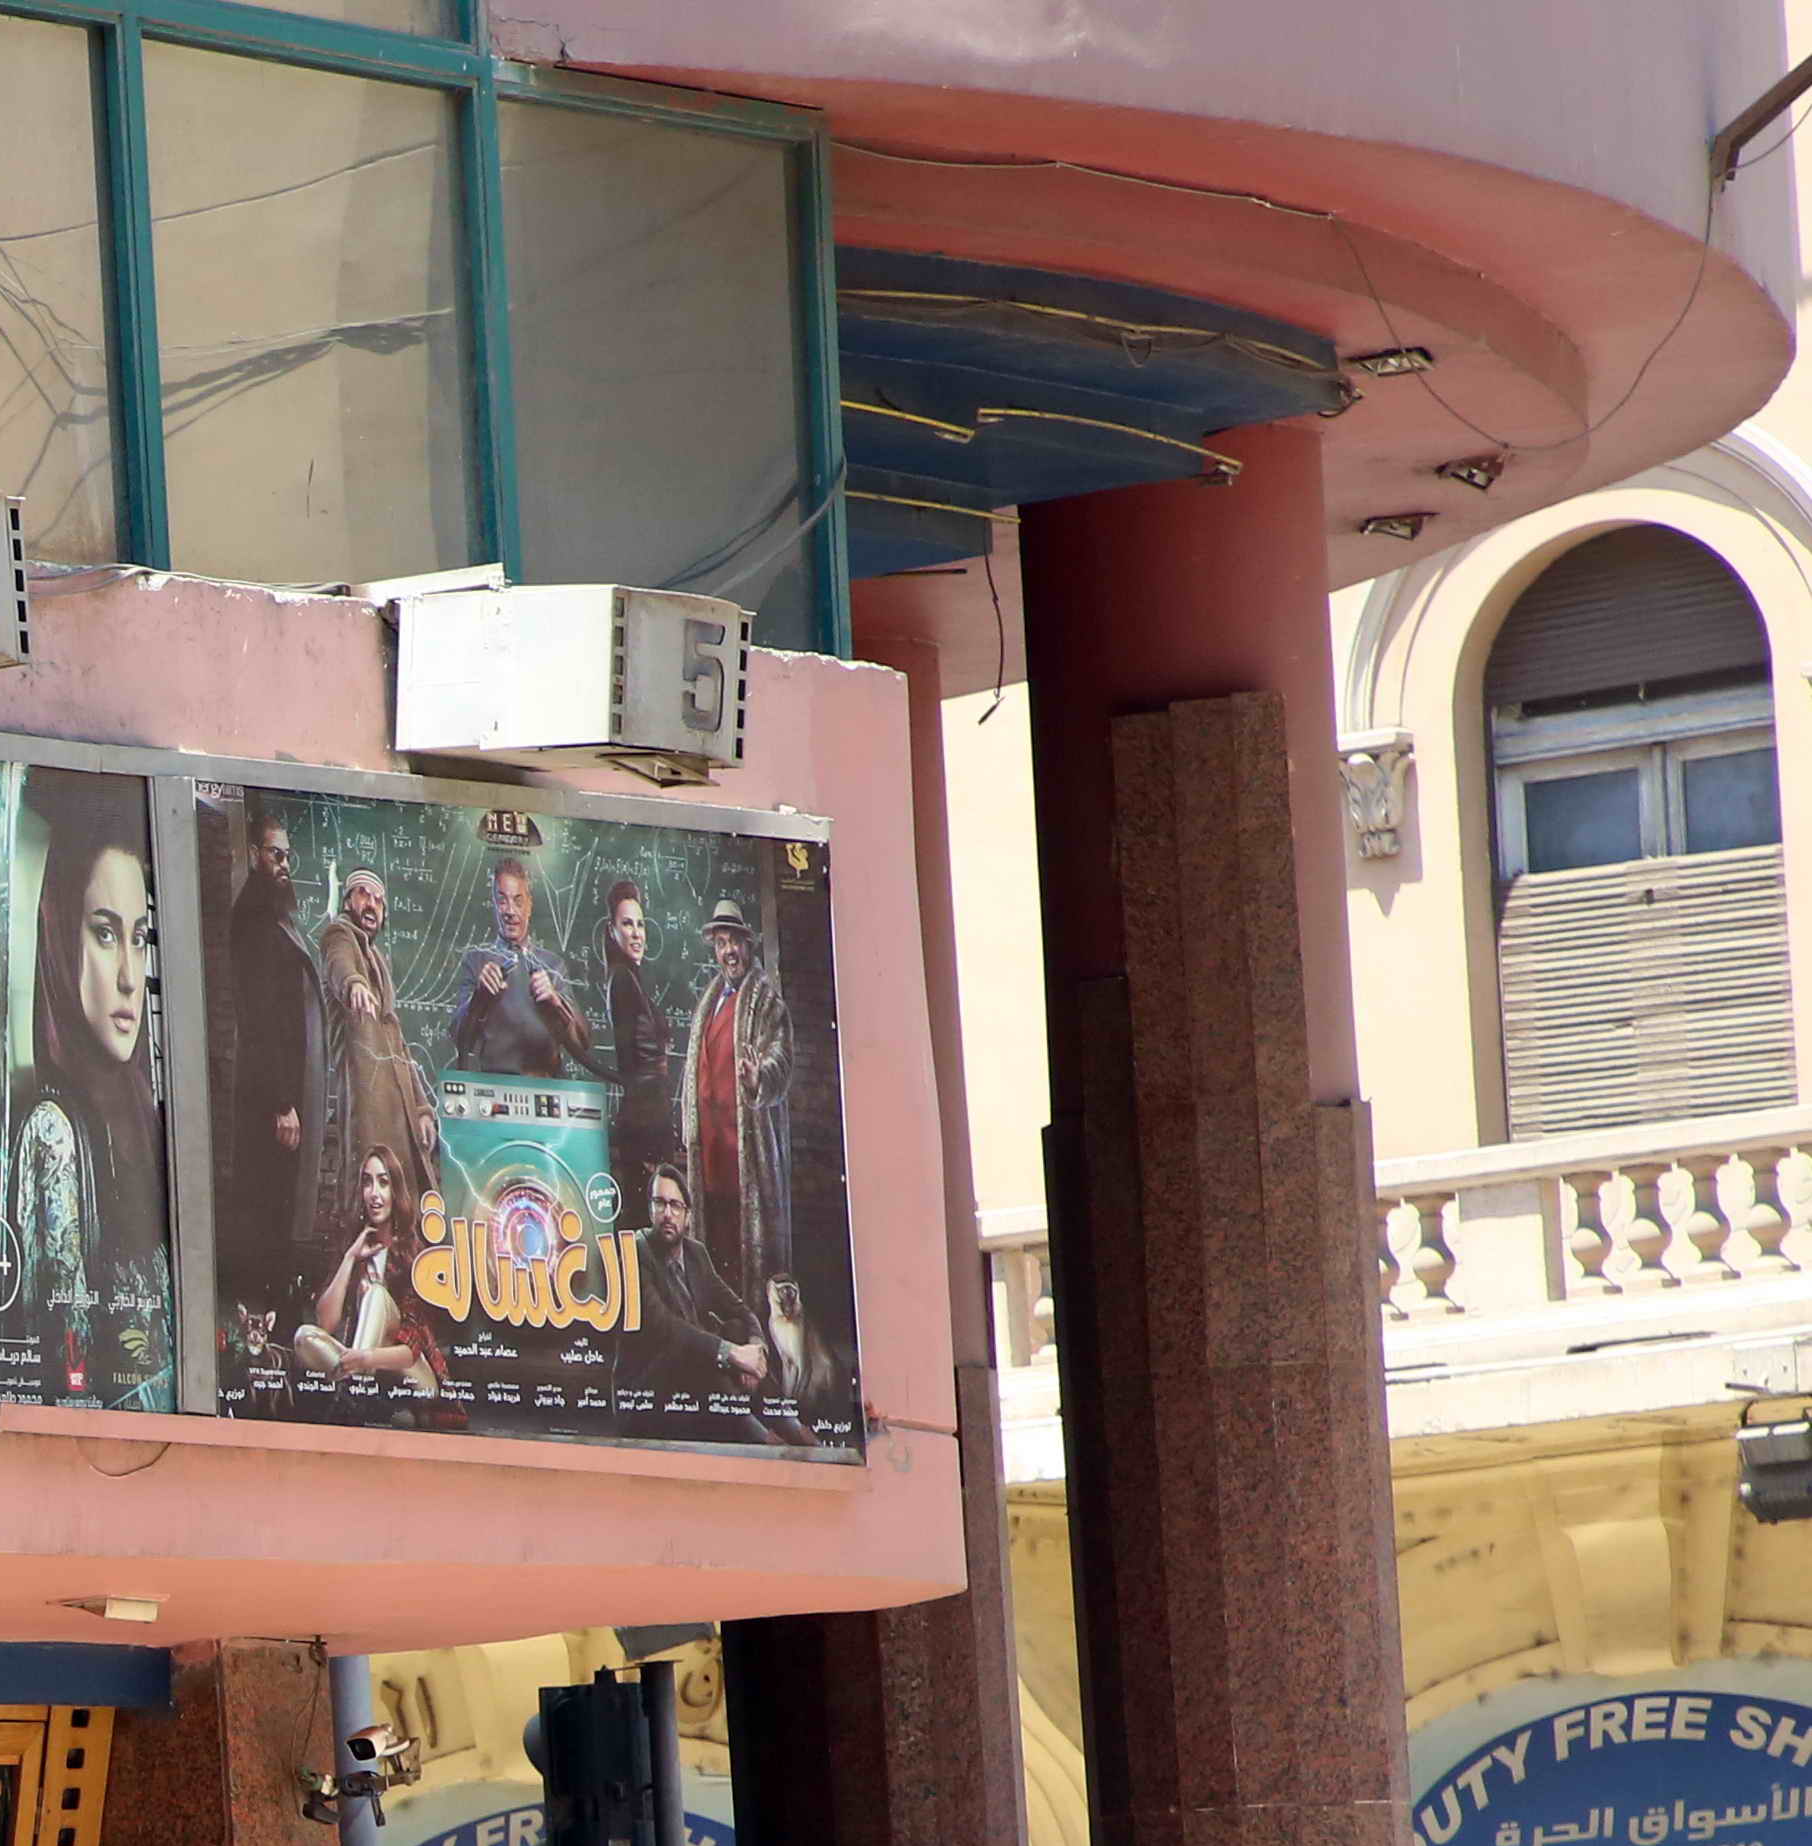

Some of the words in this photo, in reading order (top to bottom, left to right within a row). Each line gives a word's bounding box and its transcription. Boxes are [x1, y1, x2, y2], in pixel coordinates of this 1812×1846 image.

[681, 618, 726, 732] 5
[411, 1189, 641, 1332] الغسالة
[1553, 1696, 1713, 1762] FREE
[1729, 1704, 1812, 1769] SH
